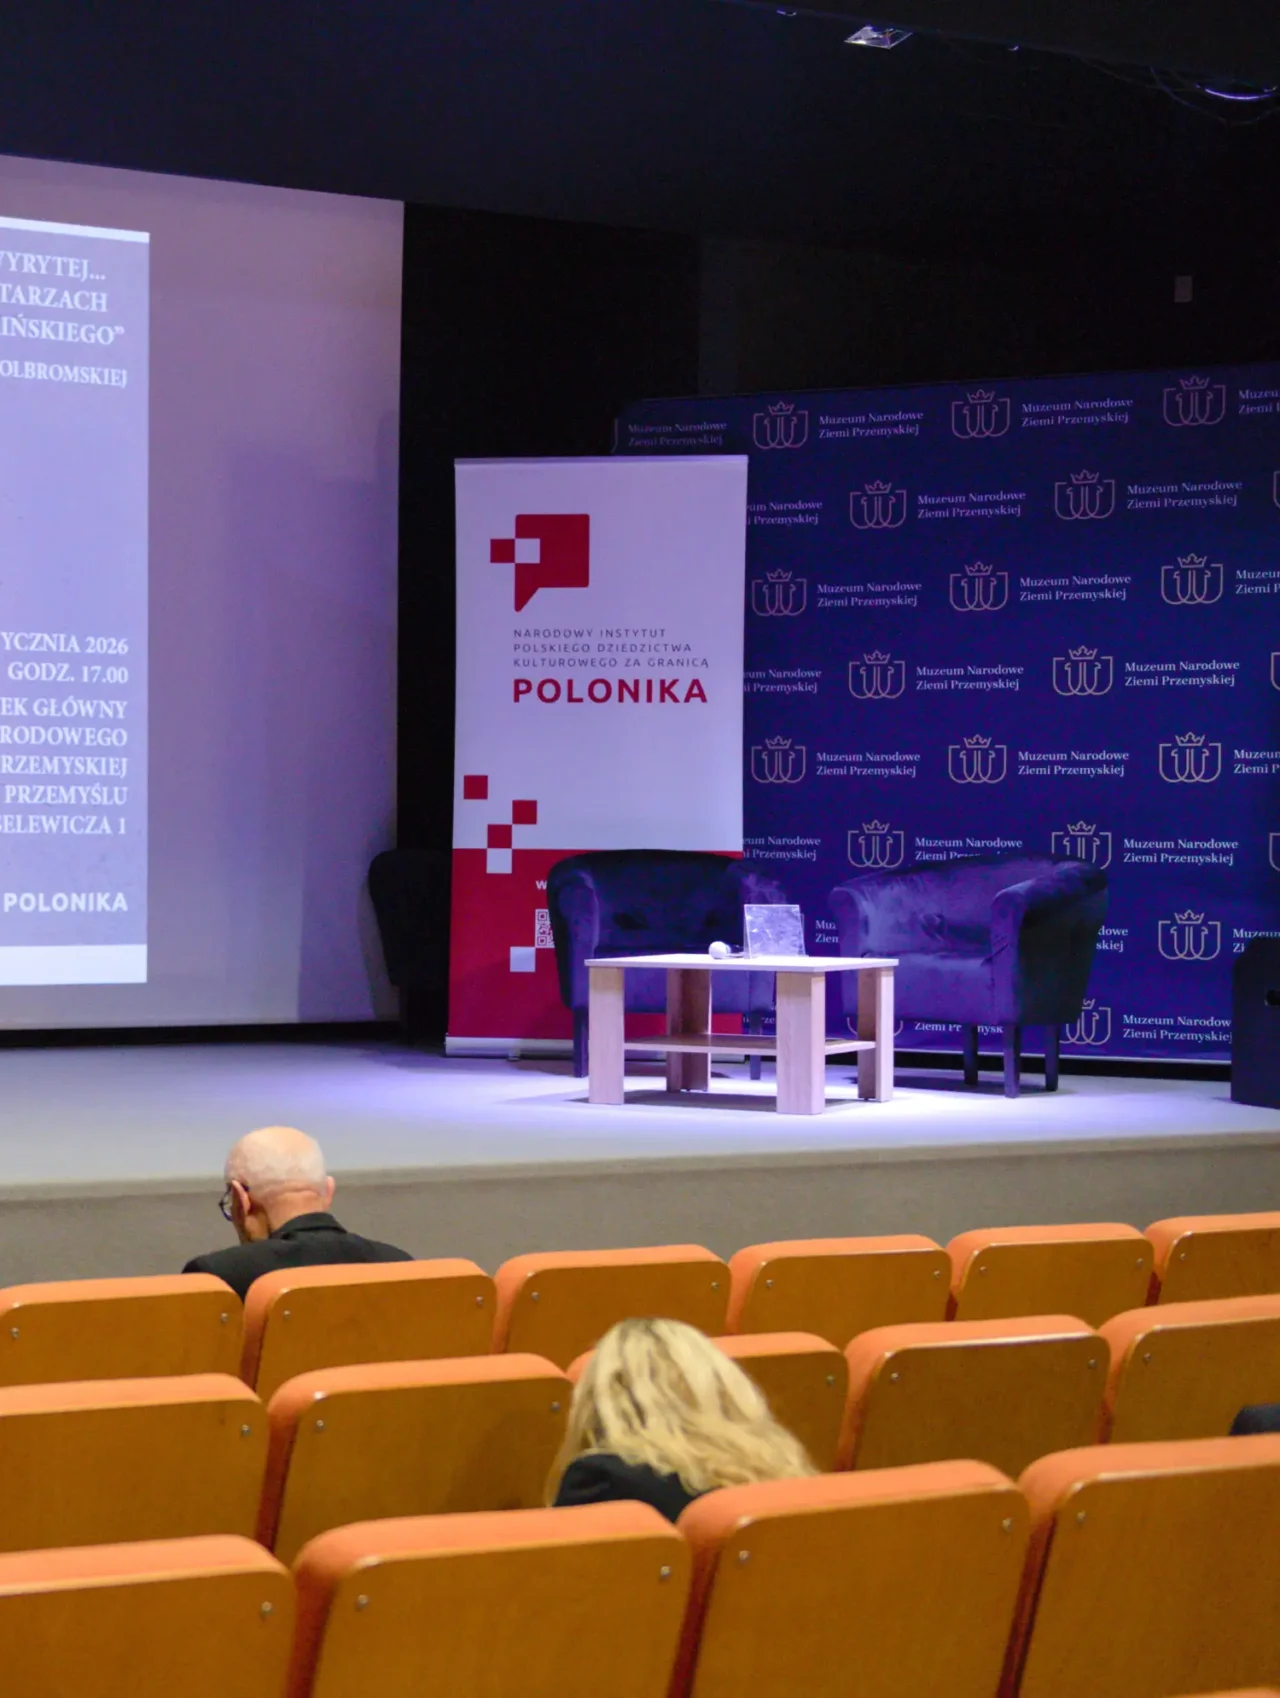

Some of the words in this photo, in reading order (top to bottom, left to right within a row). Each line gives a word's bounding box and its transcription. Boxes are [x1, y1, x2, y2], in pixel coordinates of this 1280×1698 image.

[1239, 389, 1280, 399] Muzeu
[1021, 401, 1071, 413] Muzeum
[1074, 398, 1133, 410] Narodowe
[819, 414, 865, 425] Muzeum
[869, 411, 923, 422] Narodowe
[1021, 416, 1054, 427] Ziemi
[1057, 412, 1129, 426] Przemyskiej
[819, 428, 850, 438] Ziemi
[852, 424, 919, 438] Przemyskiej
[1127, 483, 1178, 495] Muzeum
[1181, 480, 1243, 493] Narodowe
[769, 500, 822, 511] Narodowe
[918, 496, 964, 506] Muzeum
[969, 492, 1026, 503] Narodowe
[1127, 499, 1161, 509] Ziemi
[1164, 495, 1238, 509] Przemyskiej
[918, 509, 950, 519] Ziemi
[952, 506, 1021, 519] Przemyskiej
[754, 513, 819, 527] Przemyskiej
[1020, 577, 1069, 587] Muzeum
[1072, 574, 1131, 585] Narodowe
[817, 583, 863, 594] Muzeum
[866, 581, 922, 592] Narodowe
[1236, 584, 1270, 594] Ziemi
[1020, 591, 1052, 601] Ziemi
[1055, 588, 1127, 601] Przemyskiej
[817, 598, 848, 607] Ziemi
[850, 595, 918, 608] Przemyskiej
[514, 629, 593, 638] NARODOWY
[600, 628, 667, 638] INSTYTUT
[84, 636, 129, 655] 2026
[514, 643, 590, 653] POLSKIEGO
[597, 643, 692, 653] DZIEDZICTWA
[514, 658, 618, 668] KULTUROWEGO
[624, 658, 641, 667] ZA
[648, 658, 709, 669] GRANICĄ
[916, 666, 964, 676] Muzeum
[967, 664, 1024, 676] Narodowe
[1125, 662, 1176, 673] Muzeum
[1179, 660, 1240, 671] Narodowe
[7, 663, 75, 683] GODZ.
[81, 666, 129, 684] 17.00
[769, 668, 822, 678] Narodowe
[753, 681, 817, 694] Przemyskiej
[916, 681, 948, 690] Ziemi
[951, 679, 1019, 692] Przemyskiej
[1125, 677, 1158, 686] Ziemi
[1162, 675, 1235, 688] Przemyskiej
[513, 678, 708, 704] POLONIKA
[32, 694, 128, 719] GŁÓWNY
[816, 752, 863, 762] Muzeum
[865, 751, 921, 762] Narodowe
[1018, 752, 1068, 761] Muzeum
[1070, 751, 1130, 761] Narodowe
[816, 765, 847, 775] Ziemi
[850, 765, 916, 778] Przemyskiej
[1018, 765, 1051, 775] Ziemi
[1054, 765, 1125, 777] Przemyskiej
[1234, 763, 1268, 774] Ziemi
[3, 780, 128, 806] PRZEMYŚLU
[118, 816, 127, 834] 1
[767, 835, 821, 846] Narodowe
[915, 837, 963, 847] Muzeum
[966, 837, 1023, 848] Narodowe
[1124, 838, 1175, 849] Muzeum
[1177, 838, 1238, 849] Narodowe
[752, 849, 817, 862] Przemyskiej
[915, 850, 947, 861] Ziemi
[1123, 853, 1157, 863] Ziemi
[1160, 853, 1234, 866] Przemyskiej
[4, 891, 129, 913] POLONIKA
[1123, 1014, 1174, 1026] Muzeum
[1177, 1016, 1232, 1027] Narodow
[1123, 1028, 1157, 1039] Ziemi
